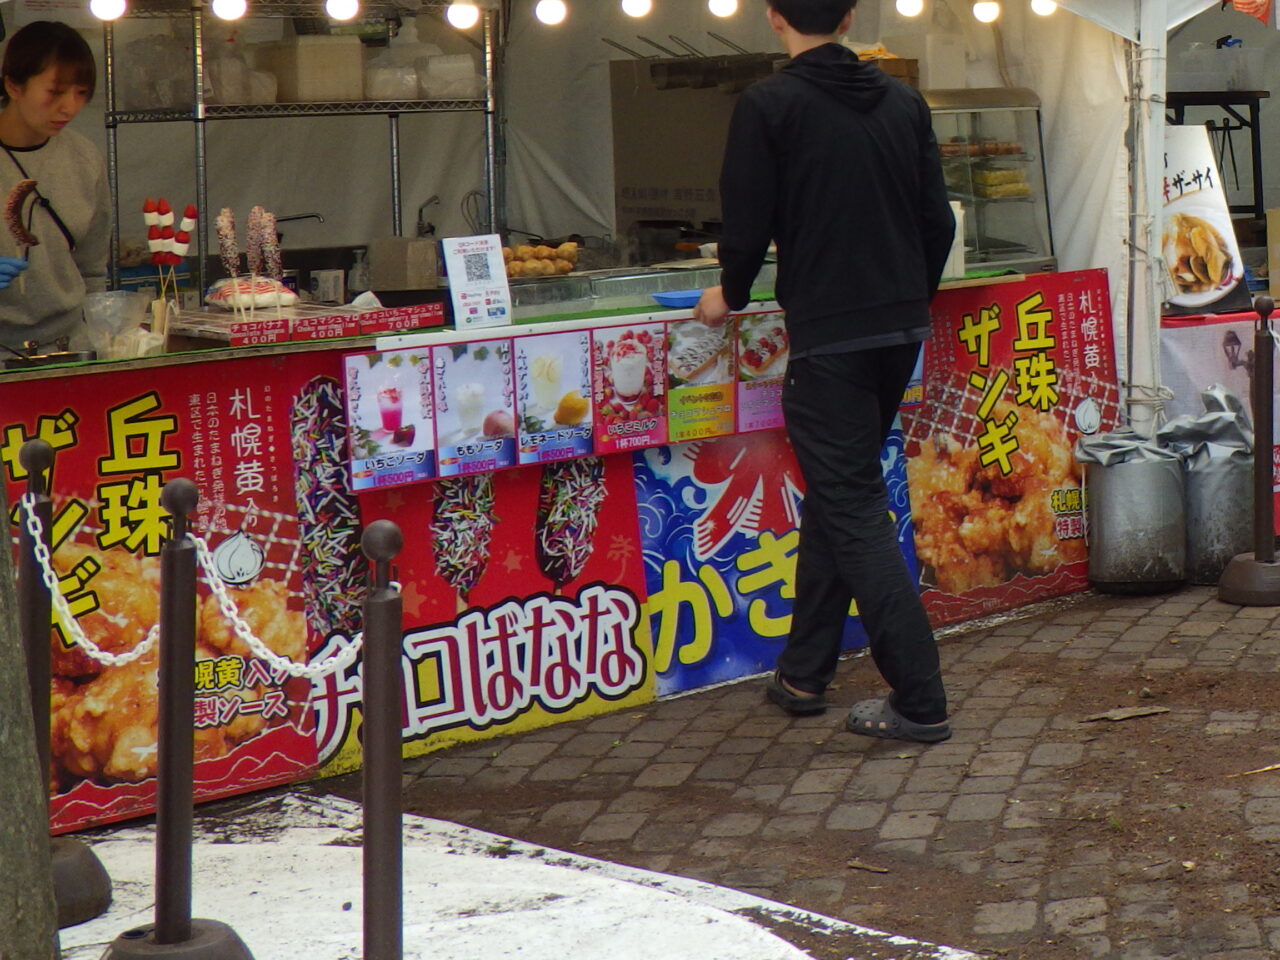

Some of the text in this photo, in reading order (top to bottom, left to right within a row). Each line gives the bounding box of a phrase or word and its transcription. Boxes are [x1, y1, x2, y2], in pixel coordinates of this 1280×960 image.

[293, 314, 360, 328] チョコマシュマロ
[363, 304, 441, 320] チョコいちごマシュマロ
[231, 320, 284, 333] チョコバナナ
[310, 327, 344, 339] 400円
[387, 318, 420, 330] 700円
[242, 333, 277, 345] 400円
[1013, 291, 1059, 413] 丘珠
[957, 302, 1020, 477] ザンギ
[519, 427, 593, 447] レモネードソーダ
[607, 419, 659, 436] いちごミルク
[227, 386, 266, 528] 札幌黄入り
[456, 440, 504, 457] ももソーダ
[364, 451, 426, 471] いちごソーダ
[98, 390, 181, 556] 丘珠
[1055, 516, 1090, 541] 特製
[650, 528, 800, 673] かき
[194, 653, 292, 693] 幌黄入り
[310, 586, 646, 766] チコばなな
[194, 695, 289, 730] 製ソース
